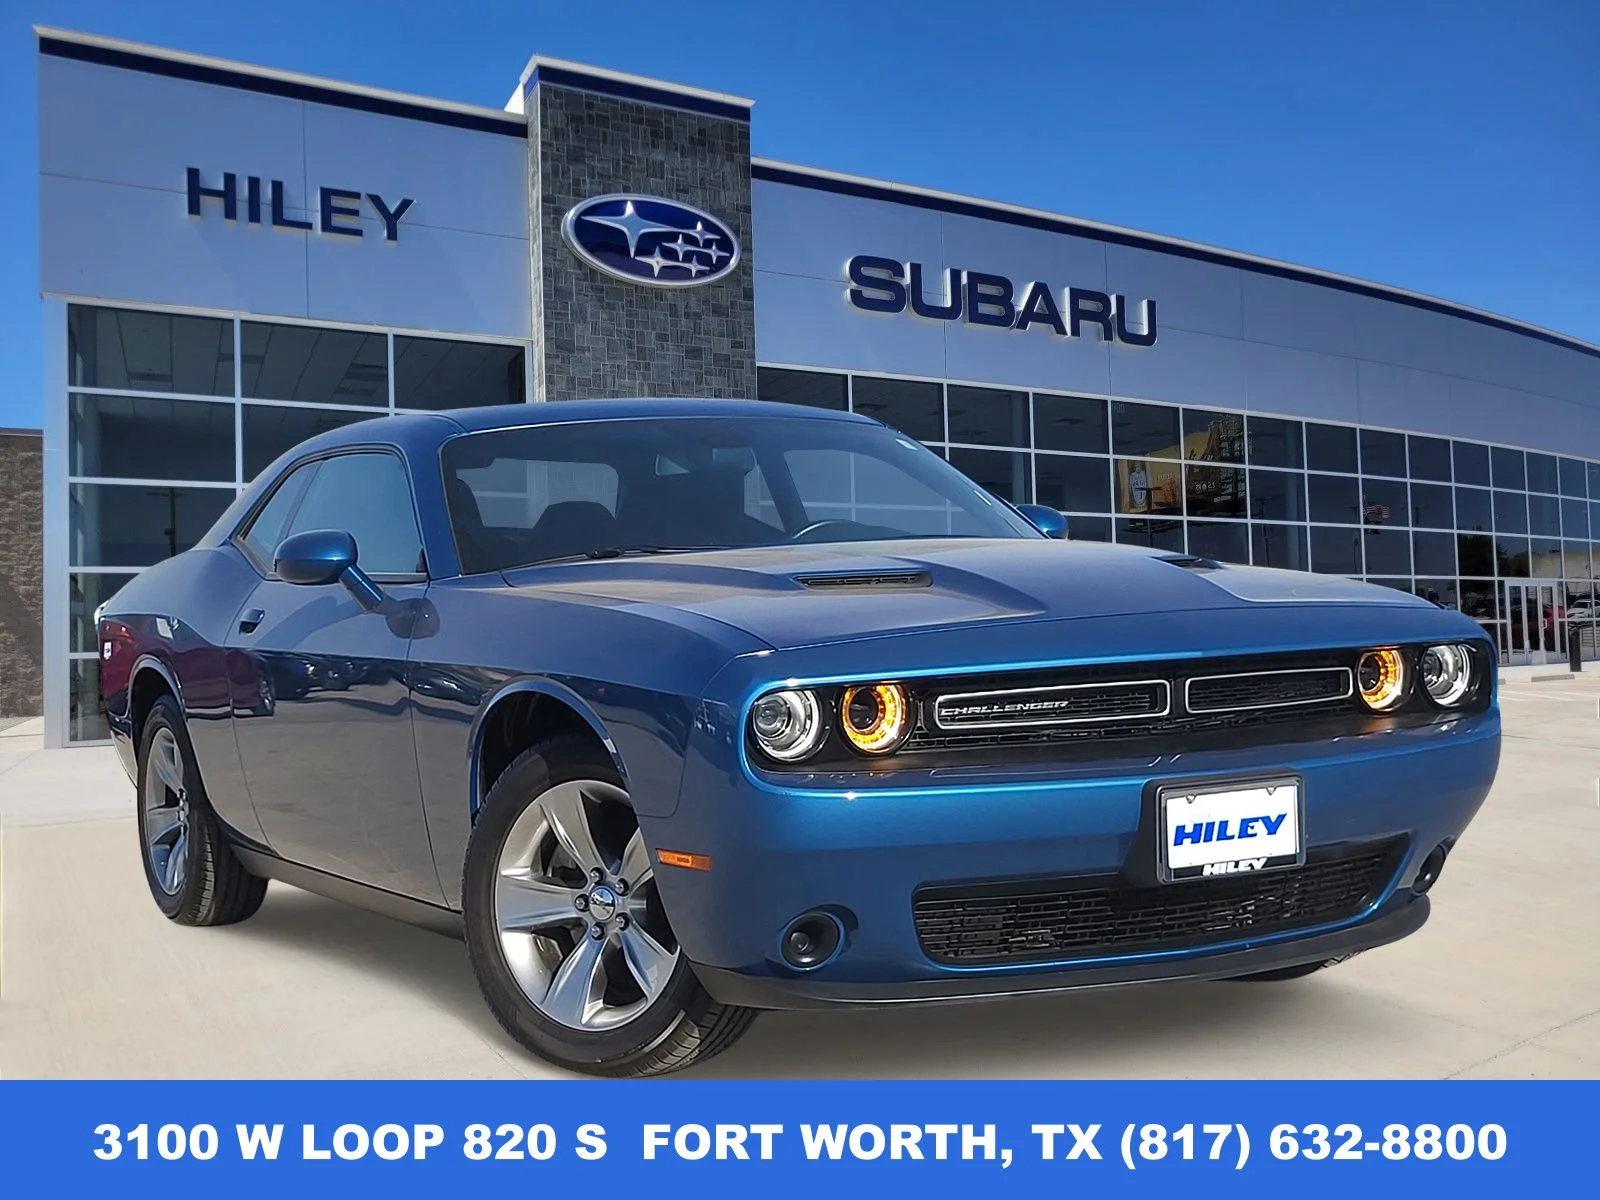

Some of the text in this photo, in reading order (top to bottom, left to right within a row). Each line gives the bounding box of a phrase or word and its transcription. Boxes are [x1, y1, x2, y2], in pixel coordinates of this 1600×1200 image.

[186, 166, 417, 242] HILEY
[846, 255, 1158, 347] SUBARU
[940, 700, 1069, 716] CHALLENGER
[1173, 812, 1288, 846] HILEY
[1202, 856, 1268, 877] HILEY
